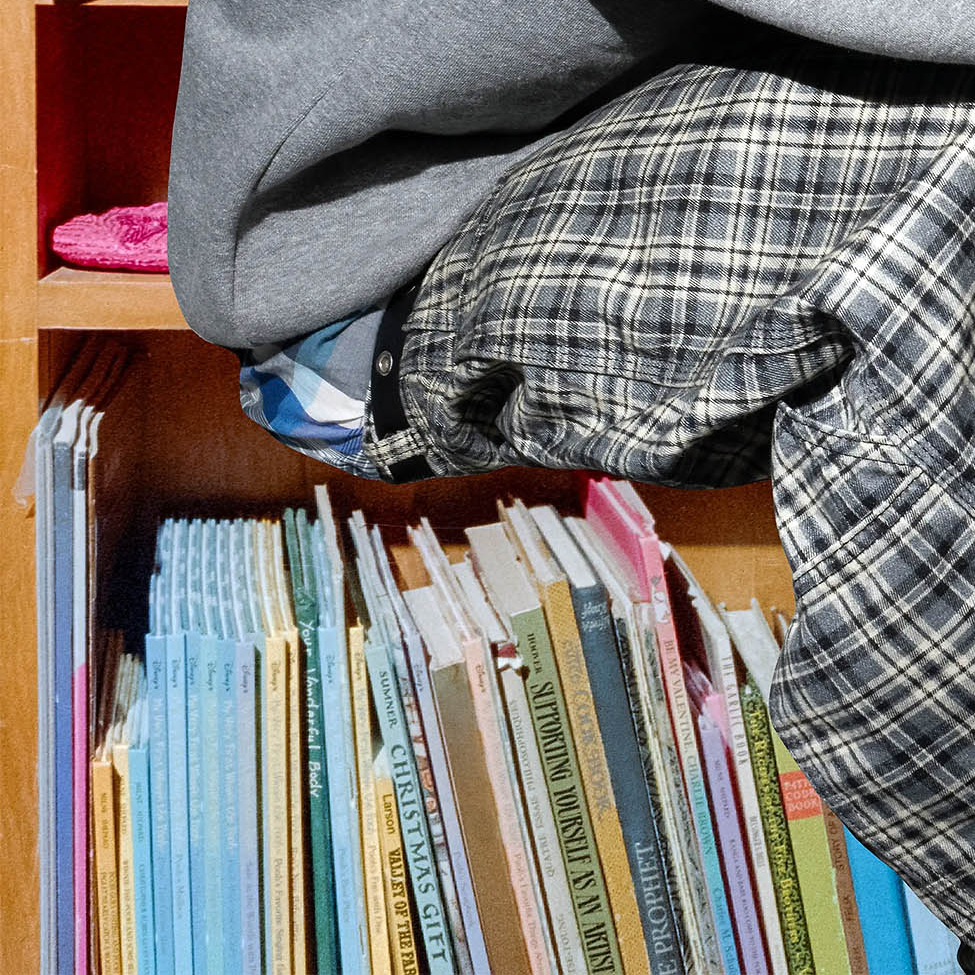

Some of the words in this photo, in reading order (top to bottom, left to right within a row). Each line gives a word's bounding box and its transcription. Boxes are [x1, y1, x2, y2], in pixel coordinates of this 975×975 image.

[352, 651, 364, 681] Disney's
[525, 632, 543, 675] HOOVER
[663, 639, 675, 655] BE
[666, 657, 680, 677] MY
[721, 656, 733, 676] THE
[152, 659, 162, 689] Disney's
[221, 661, 234, 692] Disney's
[269, 660, 282, 691] Disney's
[473, 662, 490, 694] Disney's
[298, 620, 316, 656] Your
[308, 760, 323, 798] Body
[378, 669, 399, 728] SUMNER
[669, 678, 695, 753] VALENTINE,
[724, 682, 742, 727] GARLIC
[527, 679, 574, 783] SUPPORTING
[748, 709, 765, 734] THE
[508, 697, 536, 790] PHILOSOPHIQUES
[733, 732, 749, 766] BOOK
[685, 754, 704, 805] CHARLIE
[753, 739, 776, 793] RECIPES
[381, 792, 397, 834] Larson
[551, 784, 593, 867] YOURSELF
[788, 797, 822, 813] BOOK
[389, 742, 435, 894] CHRISTMAS
[419, 901, 447, 965] GIFT
[696, 810, 714, 855] BROWN
[386, 847, 406, 899] VALLEY
[538, 834, 556, 878] QUATRE
[773, 844, 790, 875] FIVE
[569, 866, 598, 892] AS
[393, 900, 408, 918] OF
[574, 889, 603, 917] AN
[635, 842, 675, 960] PROPHET
[711, 885, 729, 926] Charles
[779, 877, 804, 943] BROTHERS
[396, 920, 412, 948] THE
[580, 916, 616, 975] ARTIST
